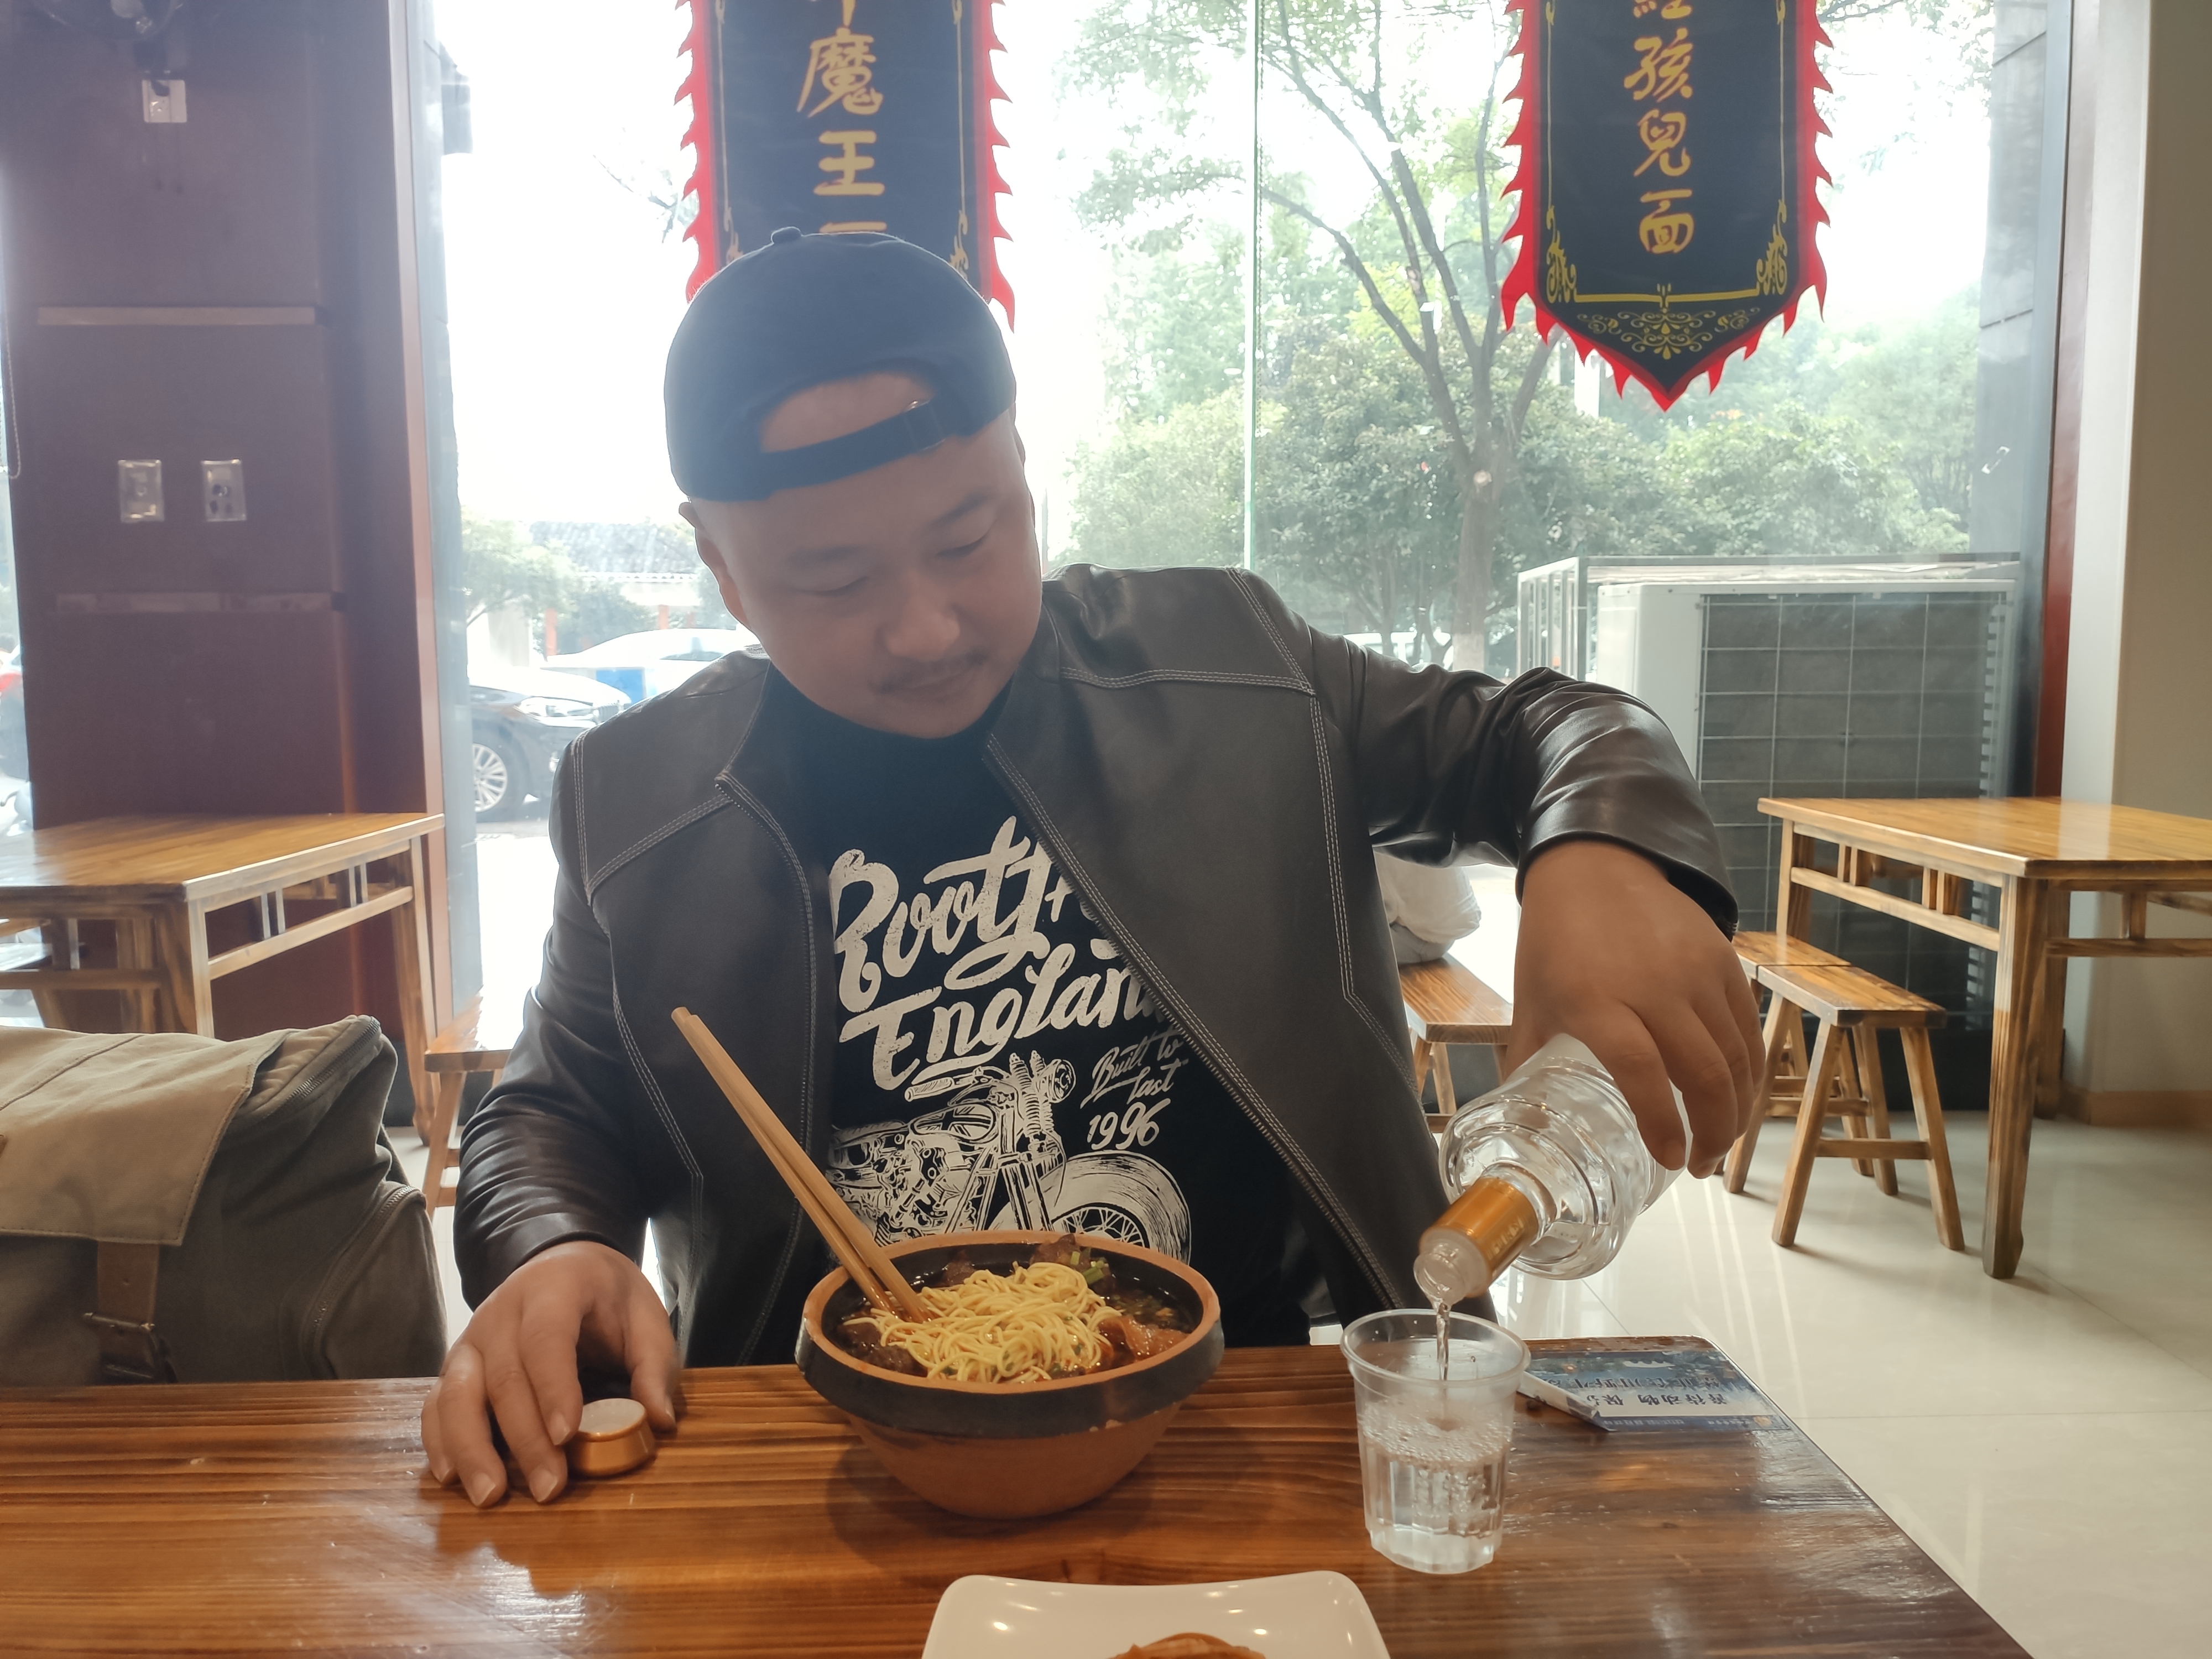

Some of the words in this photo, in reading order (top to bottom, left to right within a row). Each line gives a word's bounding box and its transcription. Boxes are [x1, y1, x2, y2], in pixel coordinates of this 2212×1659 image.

[796, 0, 887, 233] 魔王
[839, 942, 1162, 1091] Englan
[1087, 1098, 1171, 1150] 1996
